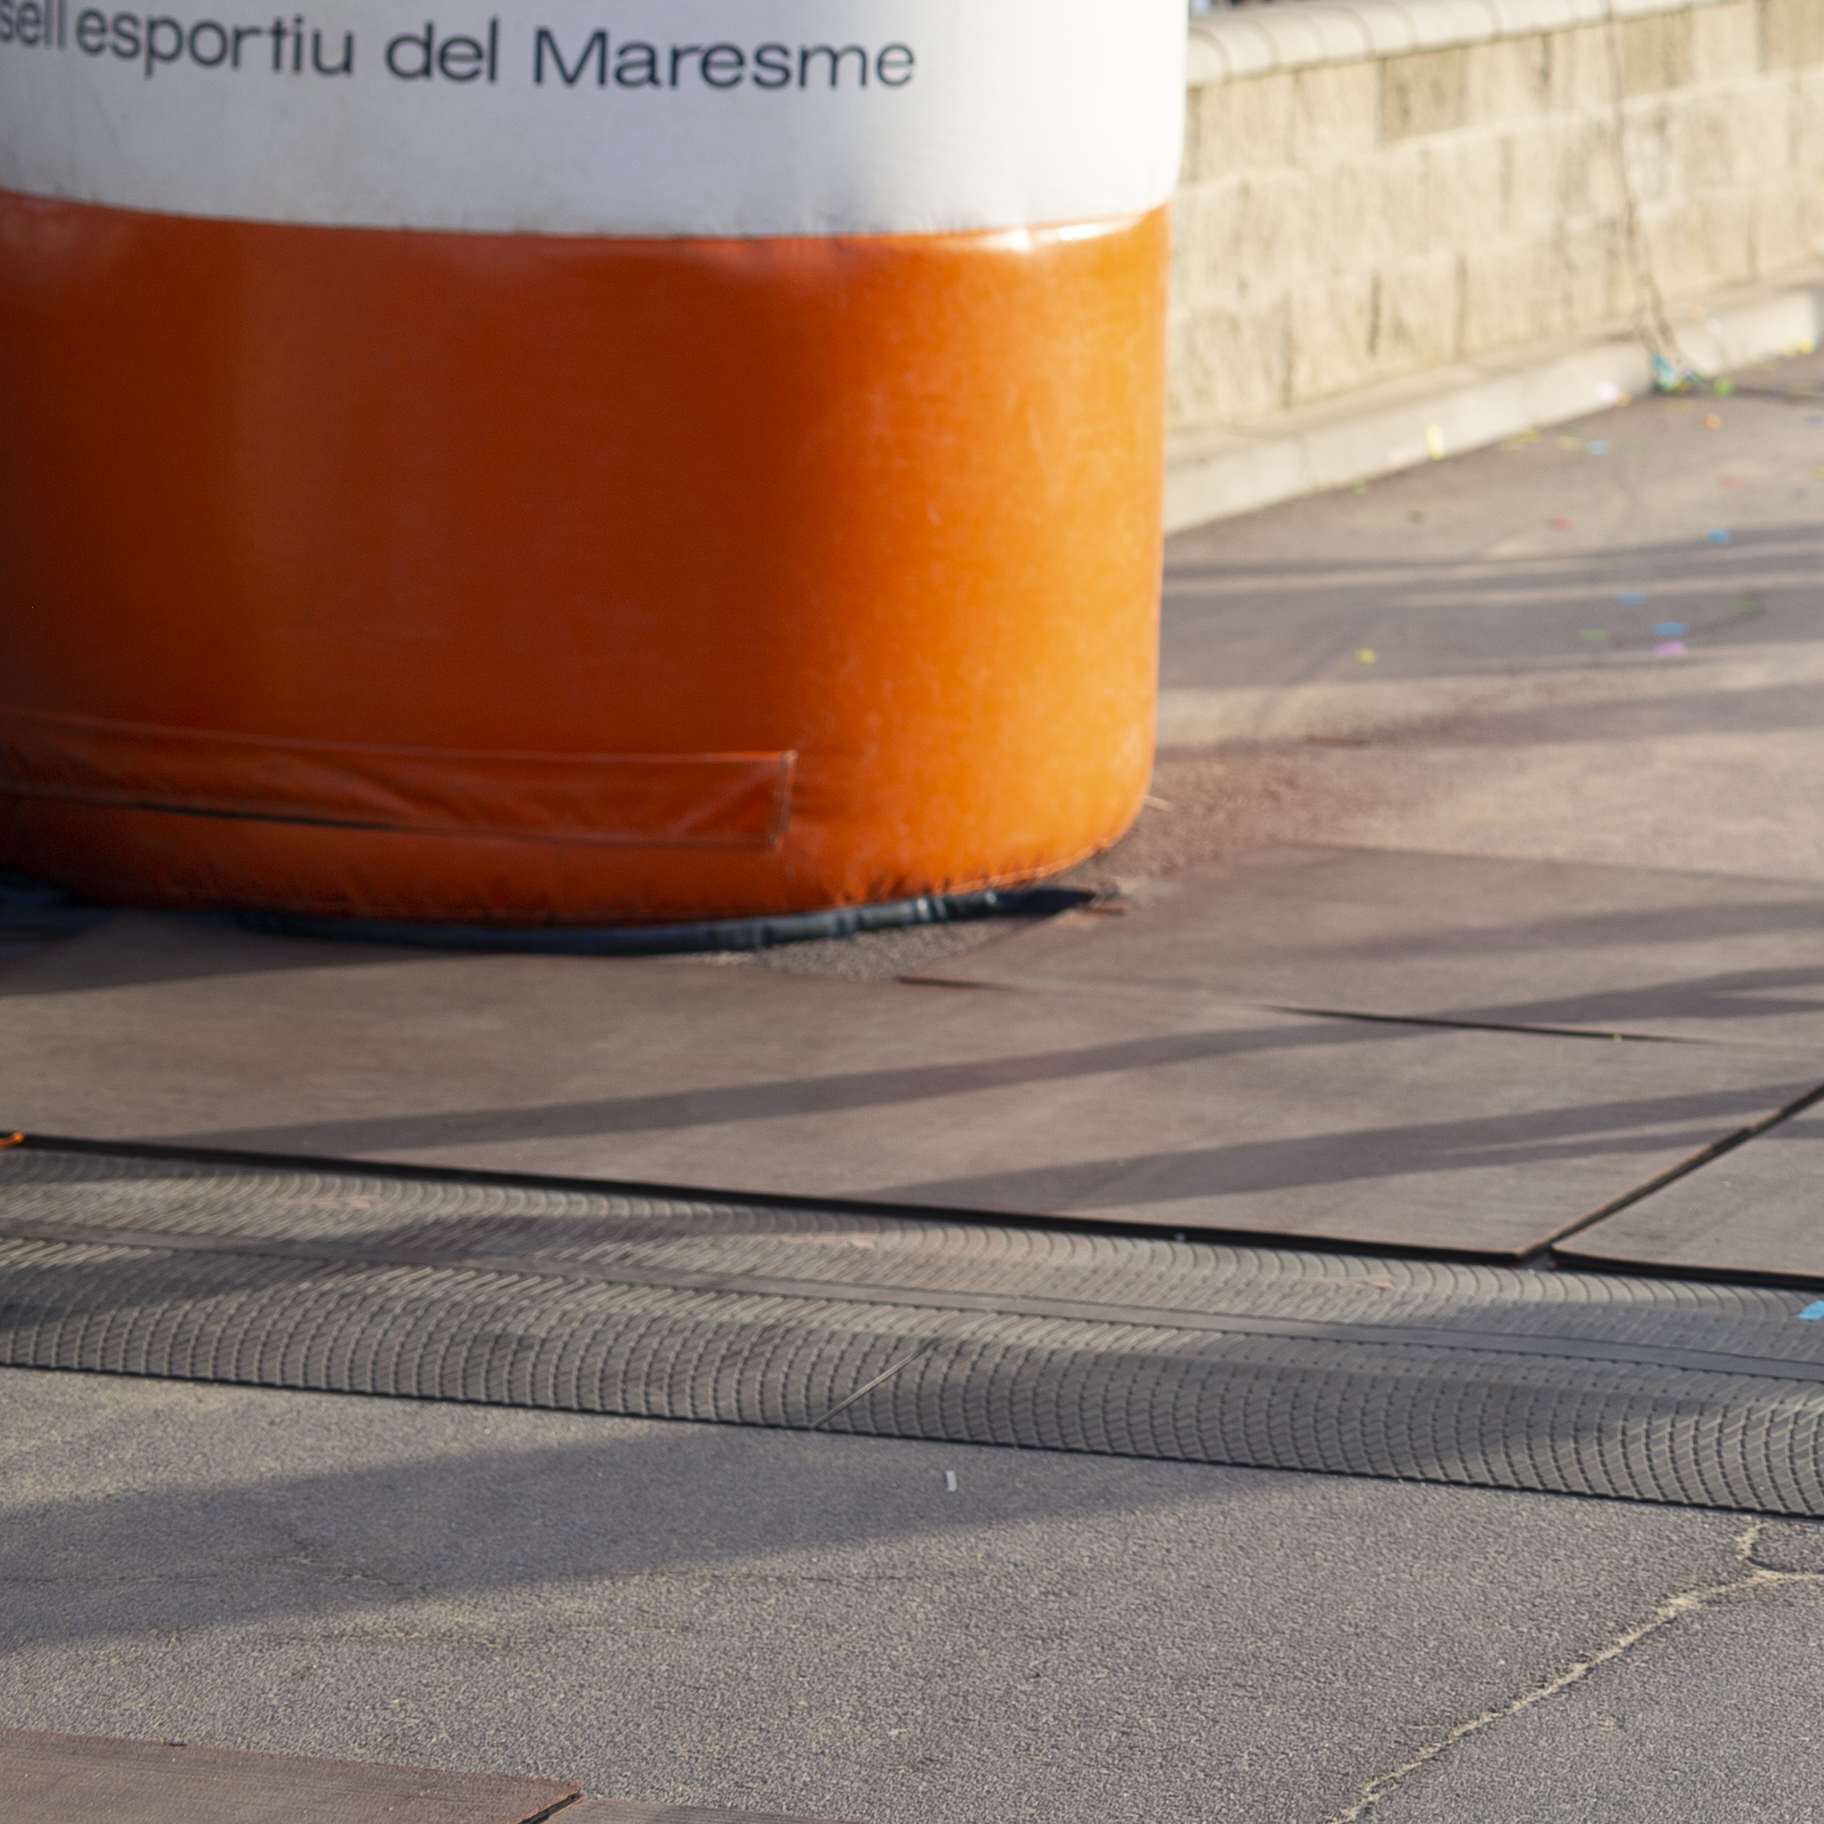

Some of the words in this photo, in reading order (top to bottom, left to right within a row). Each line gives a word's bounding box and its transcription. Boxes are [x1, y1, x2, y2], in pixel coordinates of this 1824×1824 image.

[75, 6, 356, 80] esportiu
[384, 16, 500, 85] del
[532, 26, 916, 91] Maresme
